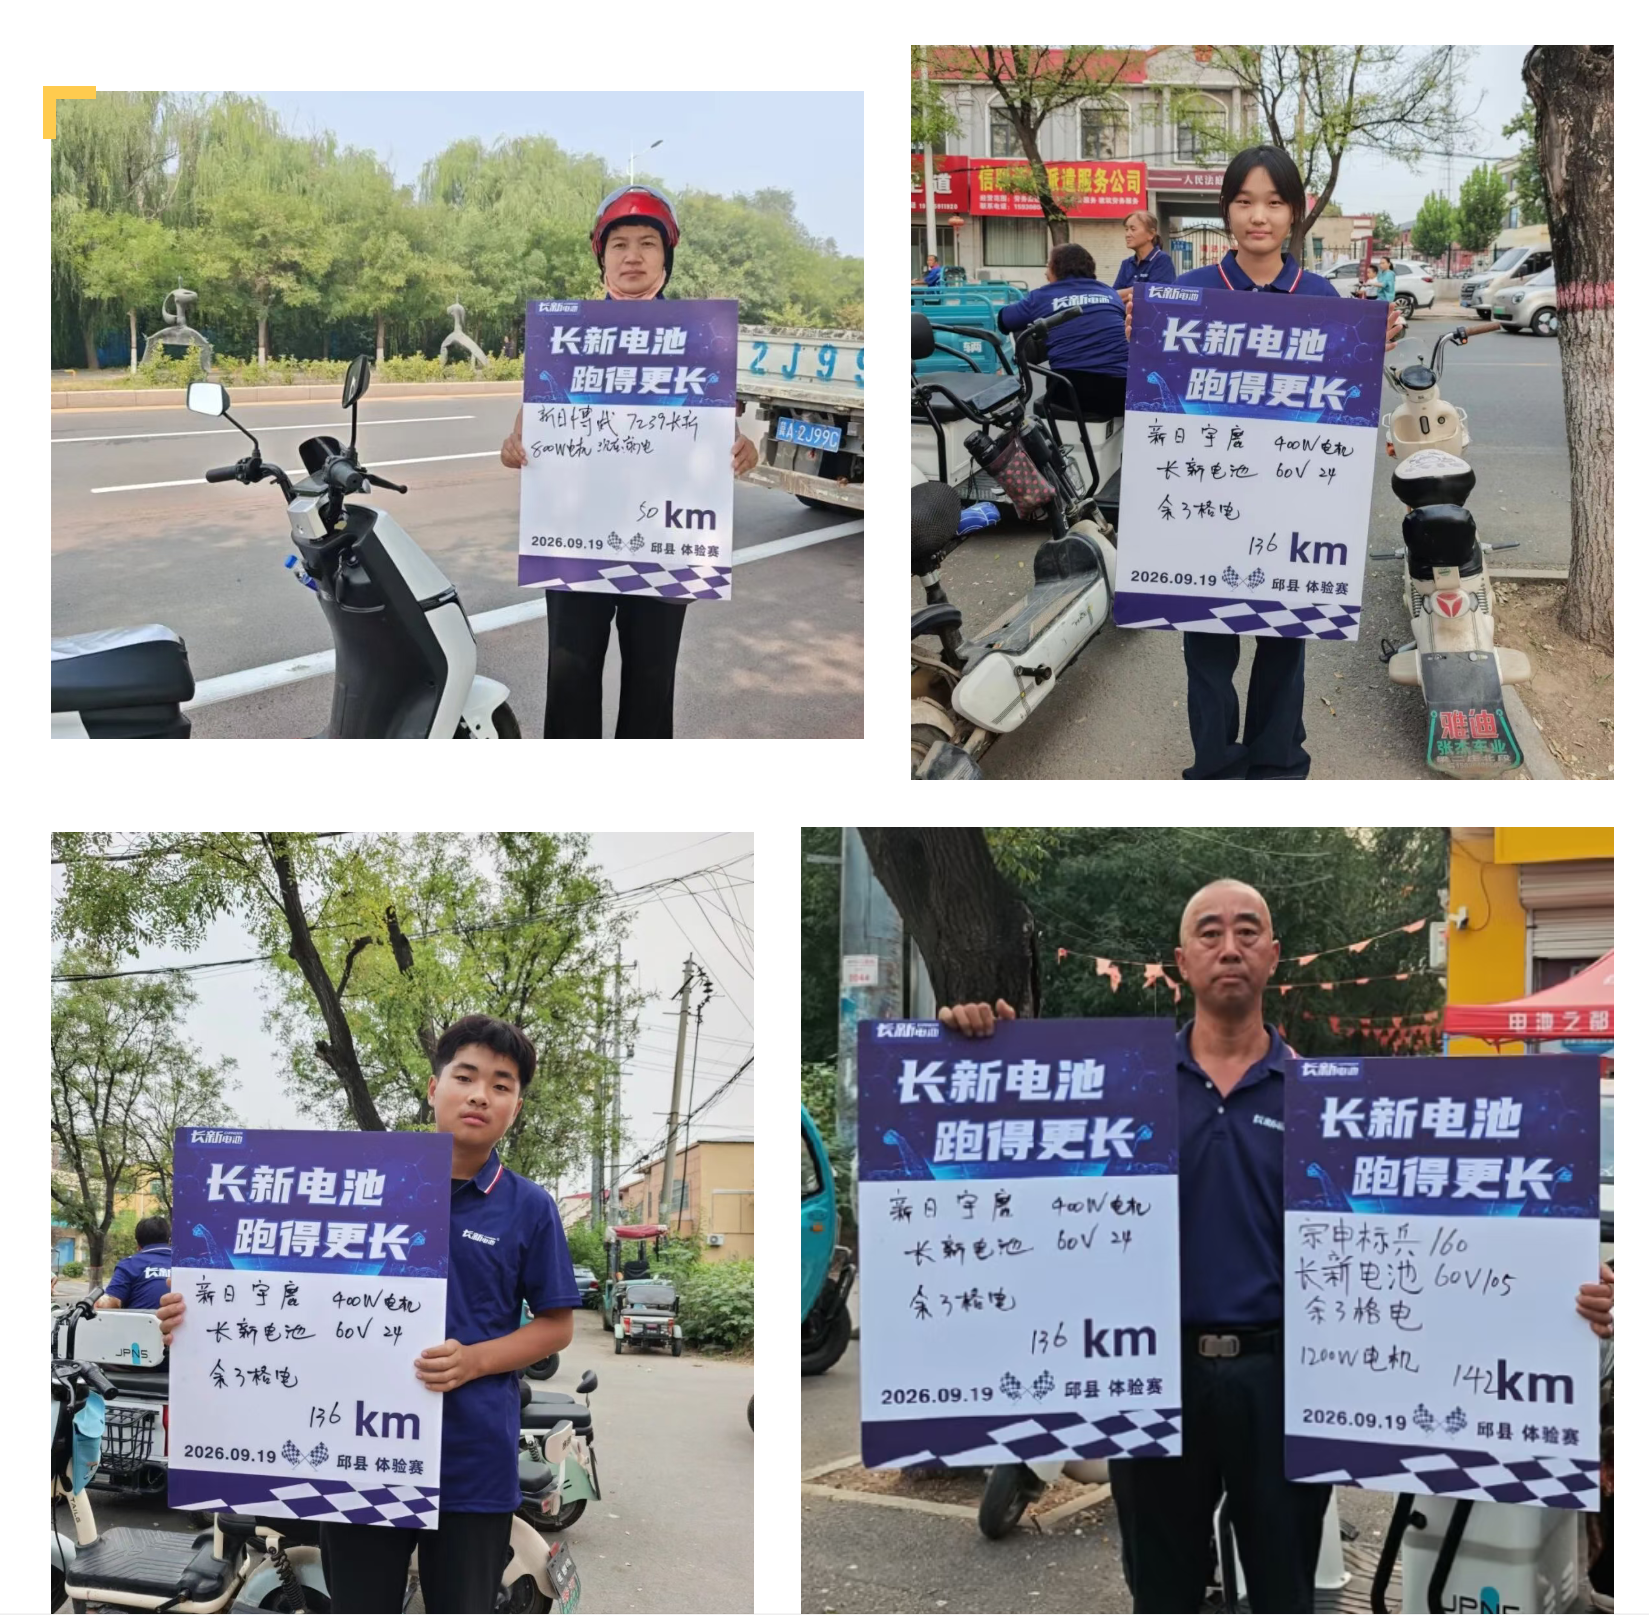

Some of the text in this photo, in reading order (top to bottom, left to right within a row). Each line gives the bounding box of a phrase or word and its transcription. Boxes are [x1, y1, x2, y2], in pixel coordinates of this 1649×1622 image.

[1148, 286, 1199, 302] 长新电池
[550, 326, 687, 355] 长新电池
[1162, 316, 1328, 362] 长新电池
[570, 366, 706, 395] 跑得更长
[1184, 368, 1348, 411] 跑得更长
[1157, 457, 1258, 481] 长新电池
[636, 500, 716, 530] 50 km
[532, 536, 720, 558] 2026.09.19 邱县 体验赛
[1249, 532, 1348, 566] 136 km
[1131, 570, 1349, 596] 2026.09.19 邱县 体验赛
[1440, 709, 1499, 739] 雅迪
[898, 1058, 1105, 1104] 长新电池
[1320, 1096, 1523, 1141] 长新电池
[191, 1130, 244, 1145] 长新电池
[933, 1117, 1136, 1163] 跑得更长
[206, 1163, 386, 1207] 长新电池
[1352, 1155, 1554, 1200] 跑得更长
[234, 1219, 410, 1262] 跑得更长
[904, 1234, 1034, 1265] 长新电池
[1294, 1250, 1424, 1296] 长新电池
[206, 1316, 316, 1341] 长新电池
[1032, 1318, 1156, 1358] 136 km
[881, 1377, 1163, 1404] 2026.09.19 邱县 体验赛
[1453, 1358, 1574, 1404] 142 km
[310, 1400, 420, 1440] 136 km
[1302, 1408, 1580, 1446] 2026.09.19 邱县 体验赛
[184, 1444, 424, 1475] 2026.09.19 邱县 体验赛
